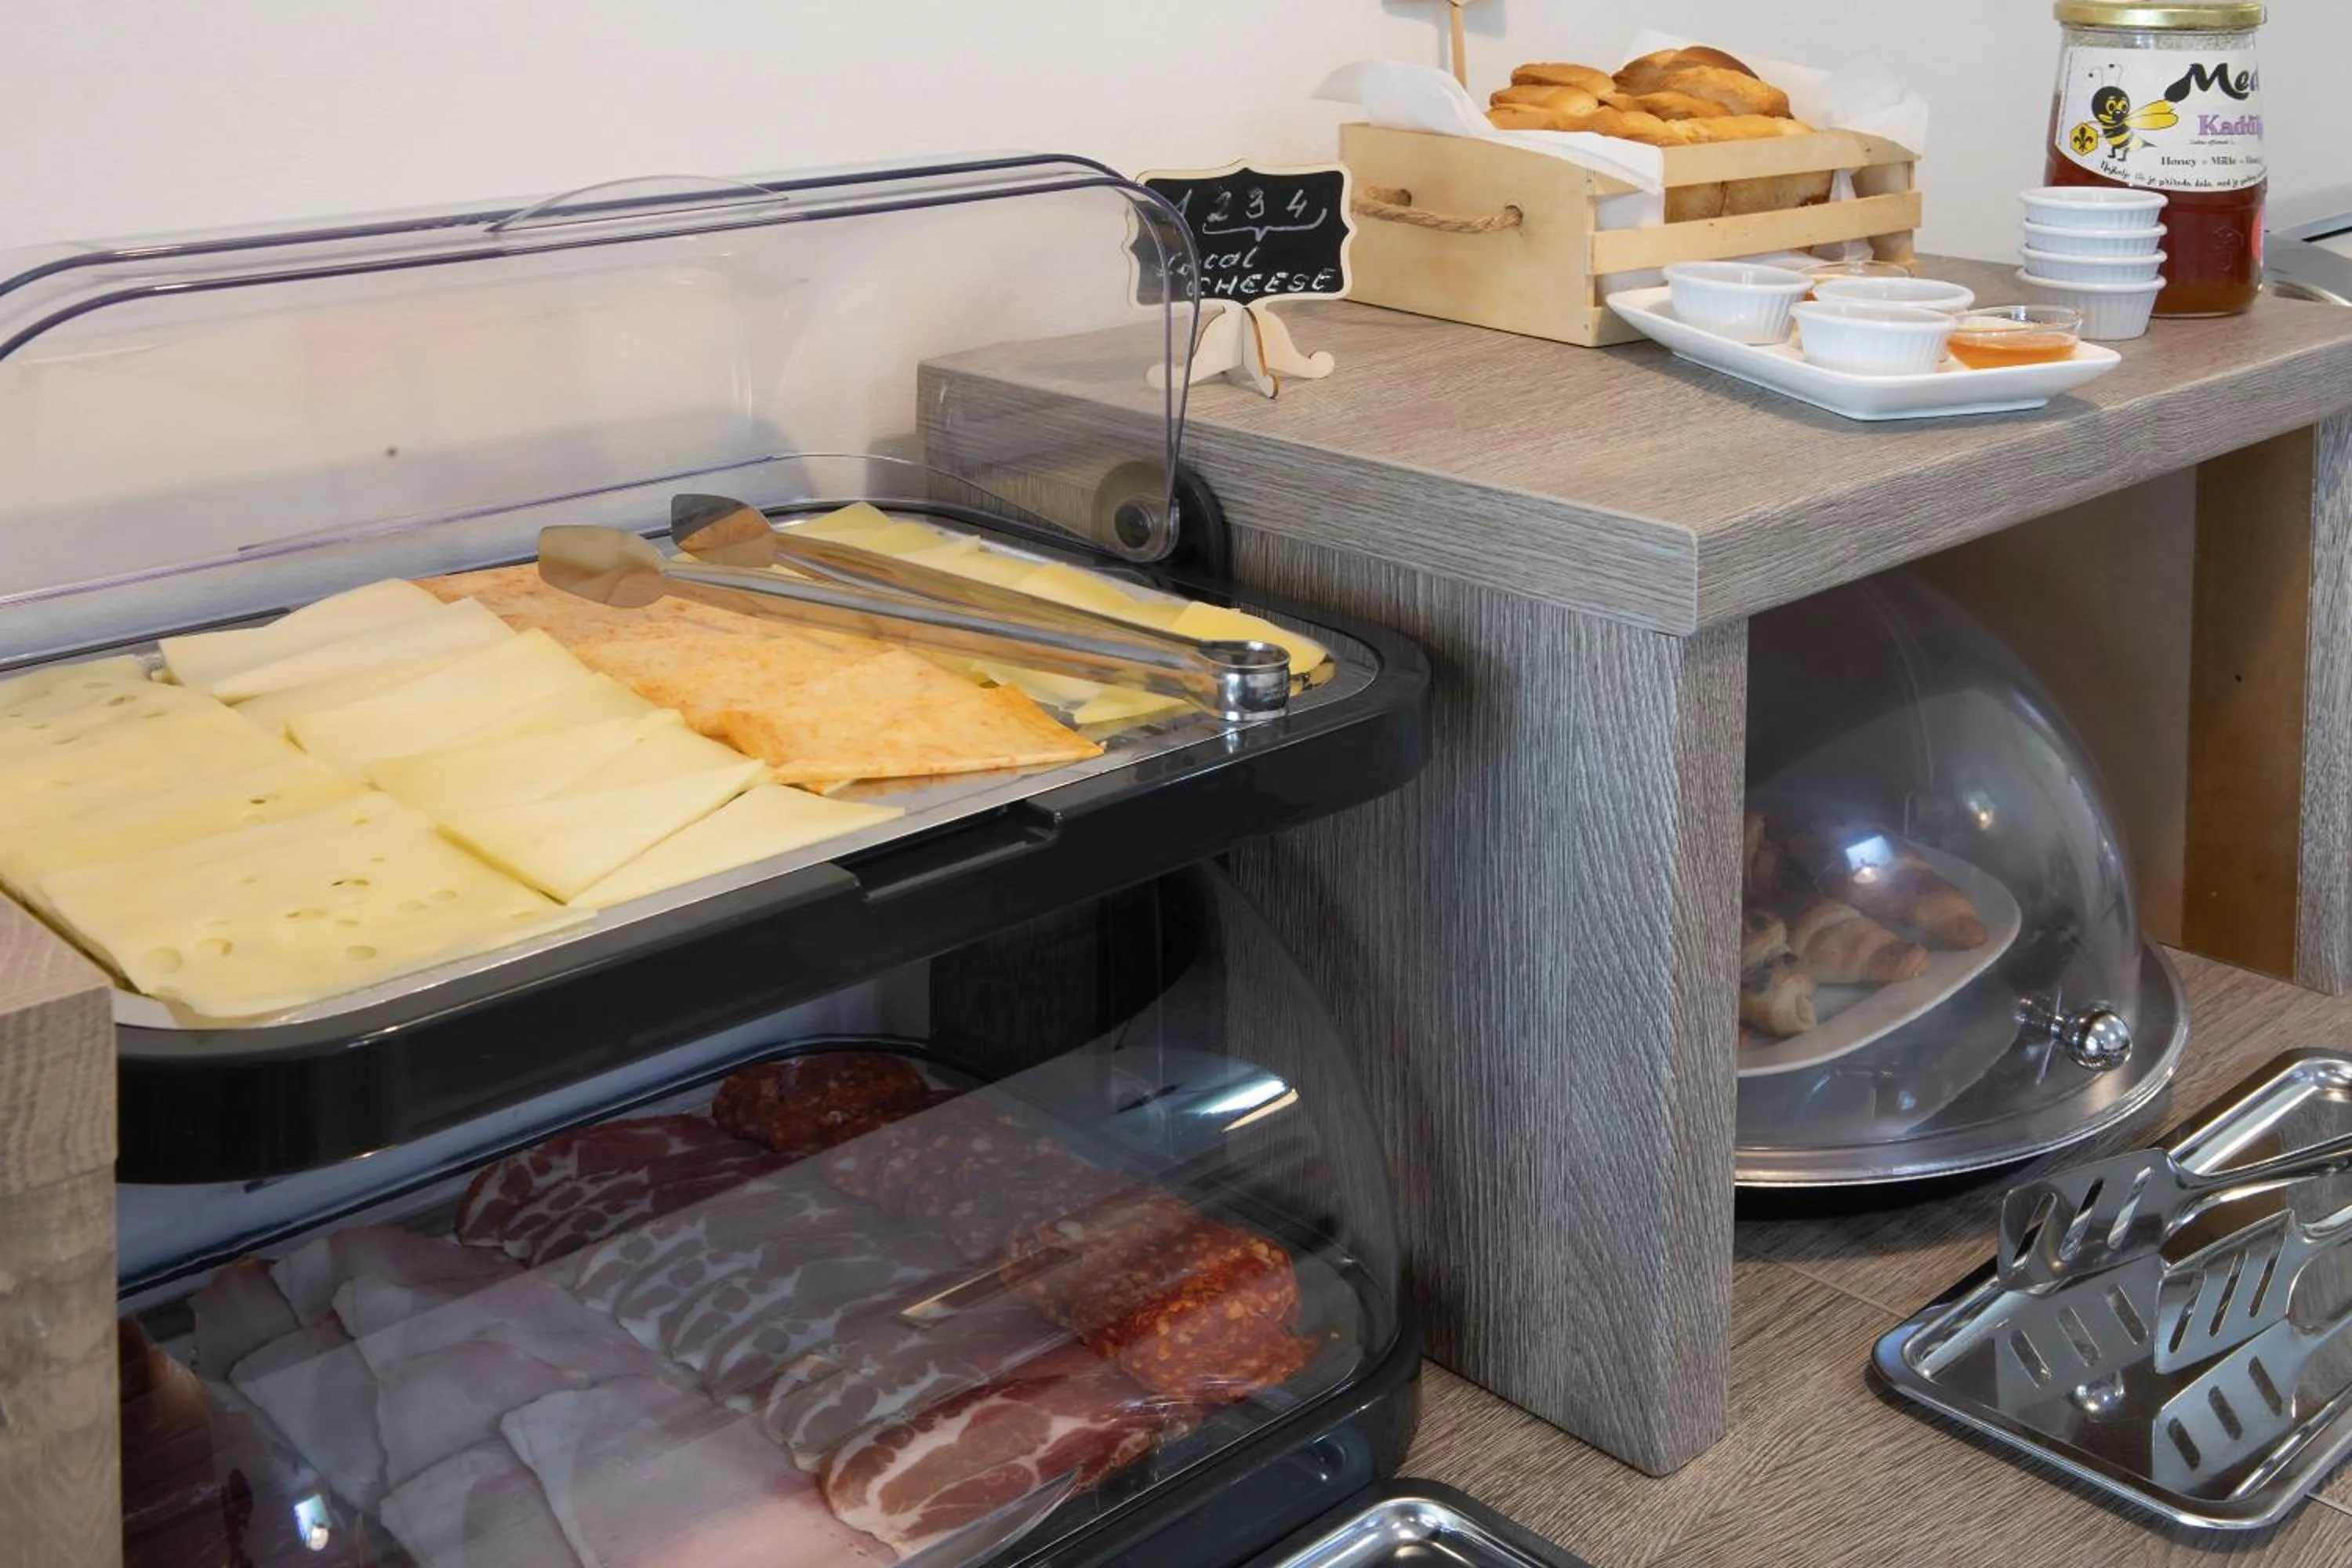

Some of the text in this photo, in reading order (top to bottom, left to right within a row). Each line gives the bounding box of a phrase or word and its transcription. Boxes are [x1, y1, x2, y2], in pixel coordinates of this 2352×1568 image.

[2161, 155, 2196, 168] Honey
[1207, 189, 1232, 223] 2
[1245, 187, 1265, 220] 3
[1286, 188, 1308, 219] 4
[1186, 267, 1336, 297] CHEESE
